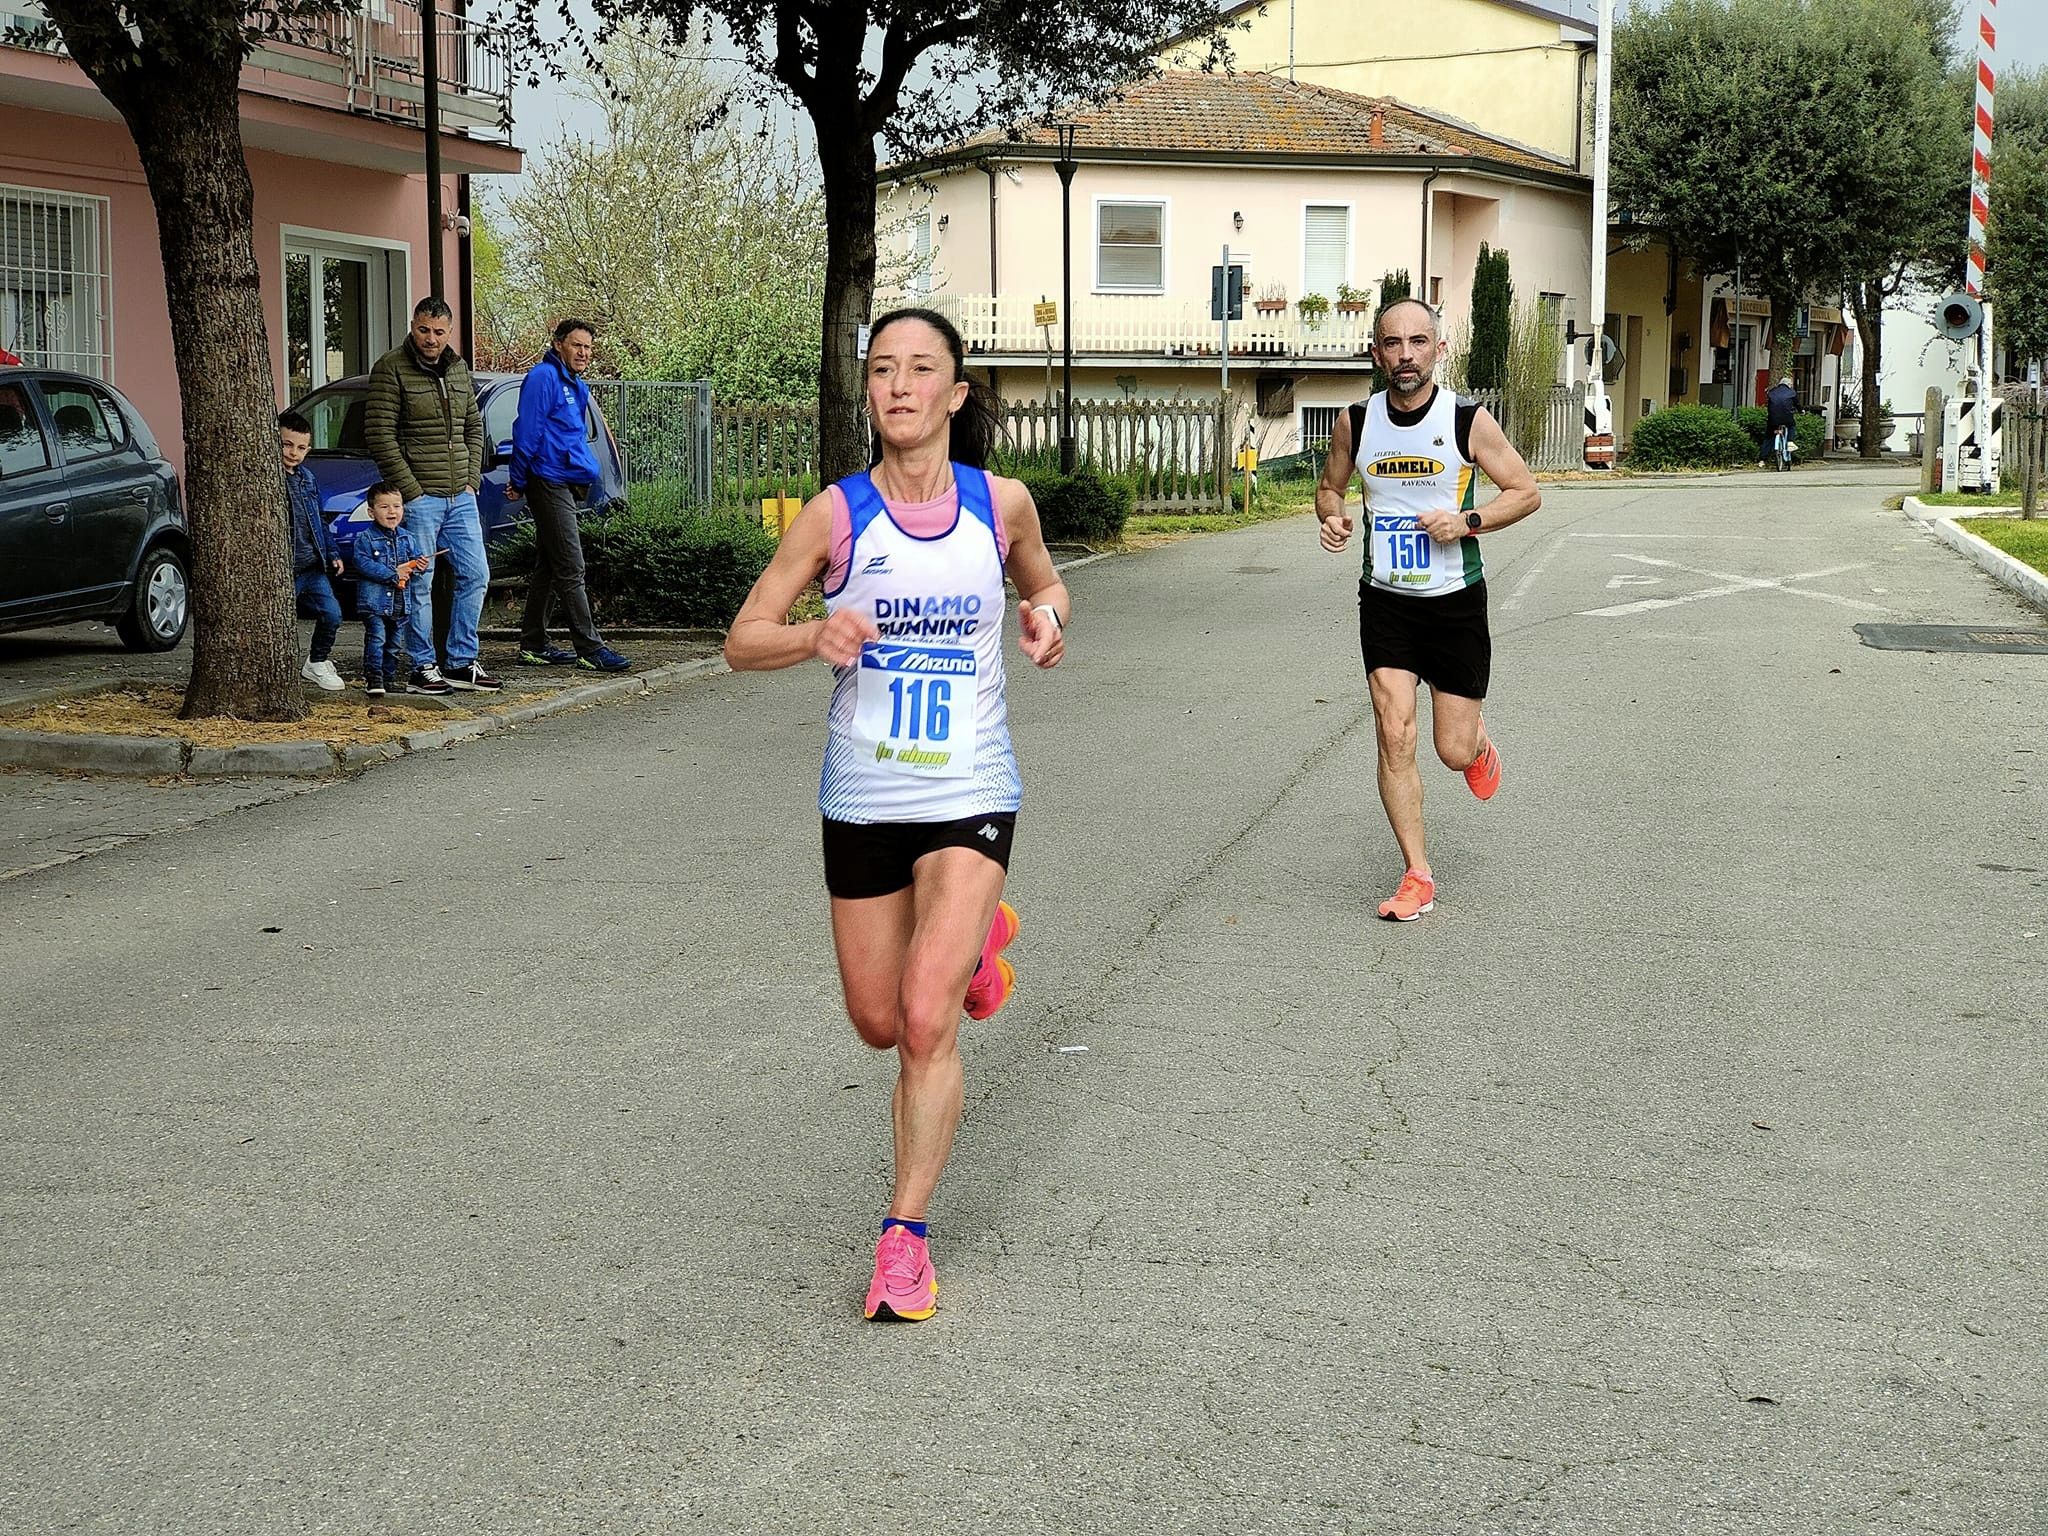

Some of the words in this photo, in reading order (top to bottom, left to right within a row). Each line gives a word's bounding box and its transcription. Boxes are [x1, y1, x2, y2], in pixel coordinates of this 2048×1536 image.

[1373, 450, 1402, 458] ATLETICA
[1376, 461, 1434, 475] MAMELI
[1401, 480, 1437, 488] RAVENNA
[1388, 533, 1431, 569] 150
[875, 594, 982, 619] DINAMO
[889, 676, 952, 742] 116
